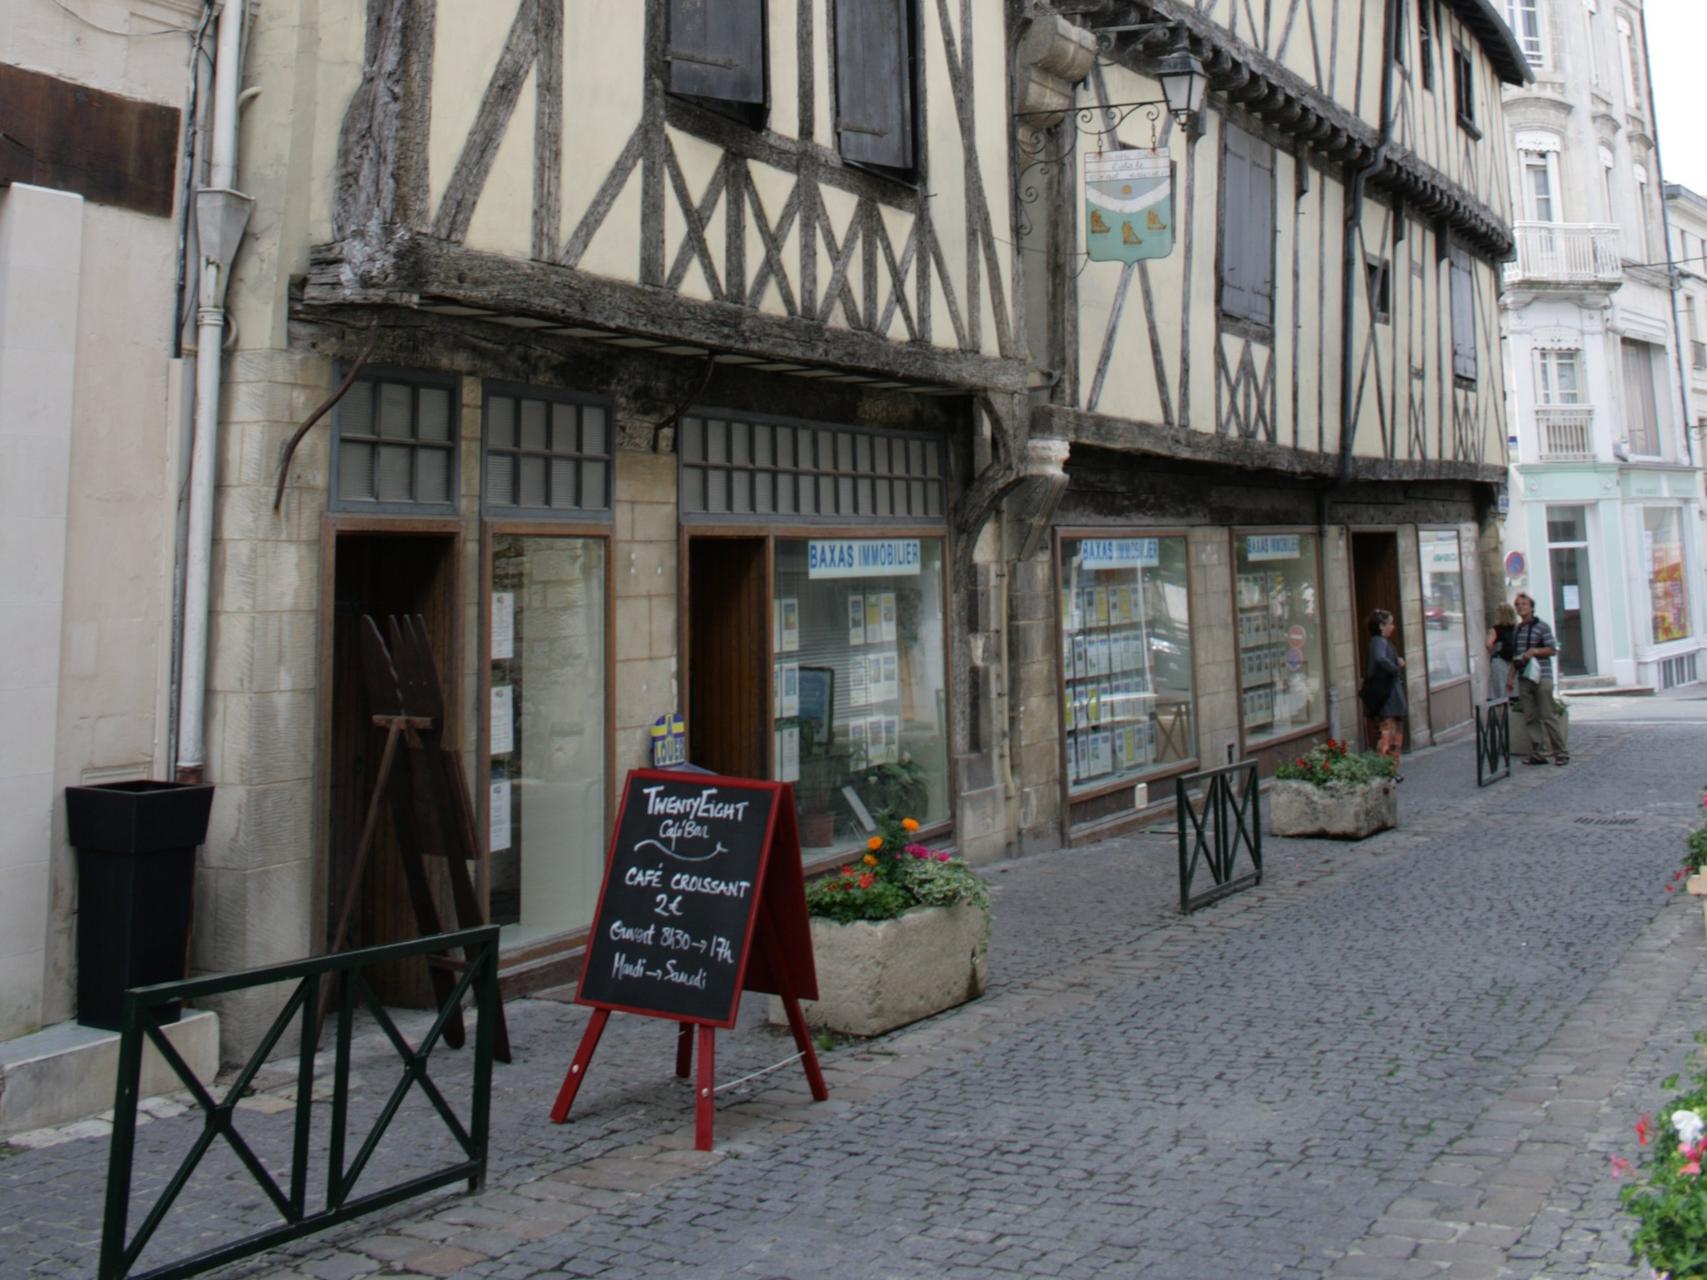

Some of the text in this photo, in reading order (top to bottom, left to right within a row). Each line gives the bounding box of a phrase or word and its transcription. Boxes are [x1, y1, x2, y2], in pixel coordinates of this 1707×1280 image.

[809, 541, 919, 569] BAXAS IMMOBILIER
[624, 862, 751, 898] CAFÉ CROISSANT
[653, 893, 683, 916] 2€
[609, 919, 656, 946] Ouvert
[710, 935, 735, 964] 17h
[611, 951, 708, 991] Mardi Samedi
